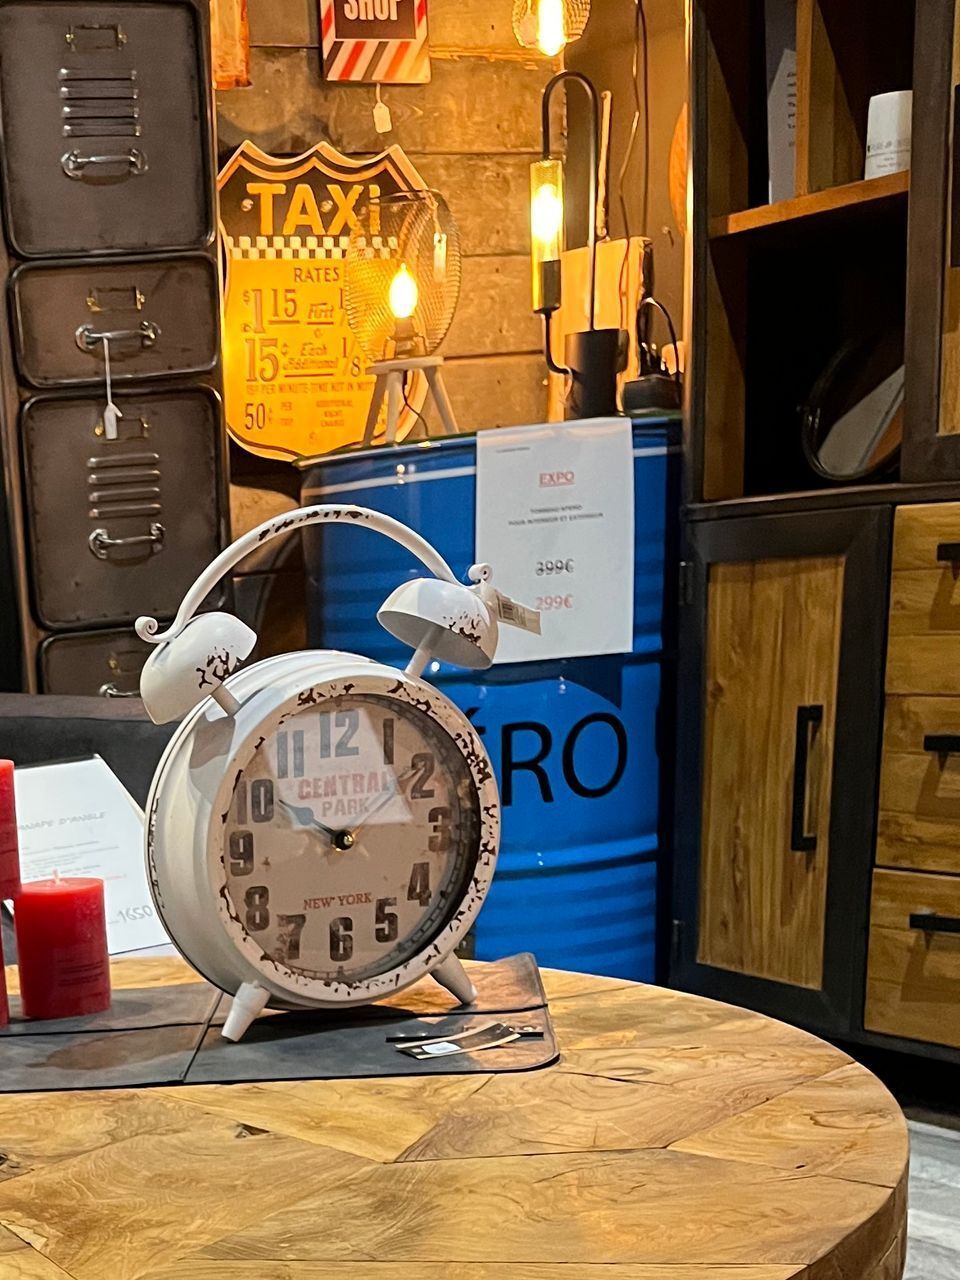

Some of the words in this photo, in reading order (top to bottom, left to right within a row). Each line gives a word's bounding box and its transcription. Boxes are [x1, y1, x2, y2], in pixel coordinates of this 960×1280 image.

[294, 267, 339, 283] RATES
[539, 470, 575, 486] EXPO
[536, 593, 573, 611] 299€
[276, 730, 305, 779] 11
[319, 709, 359, 758] 12
[383, 718, 394, 765] 1
[298, 771, 390, 800] CENTRAL
[411, 753, 435, 799] 2
[235, 778, 274, 825] 10
[322, 797, 369, 818] PARK
[428, 806, 452, 852] 3
[229, 830, 254, 877] 9
[304, 896, 334, 910] NEW
[338, 893, 372, 907] YORK
[407, 862, 432, 906] 4
[245, 886, 269, 932] 8
[375, 898, 398, 942] 5
[277, 914, 306, 960] 7
[329, 917, 353, 961] 6
